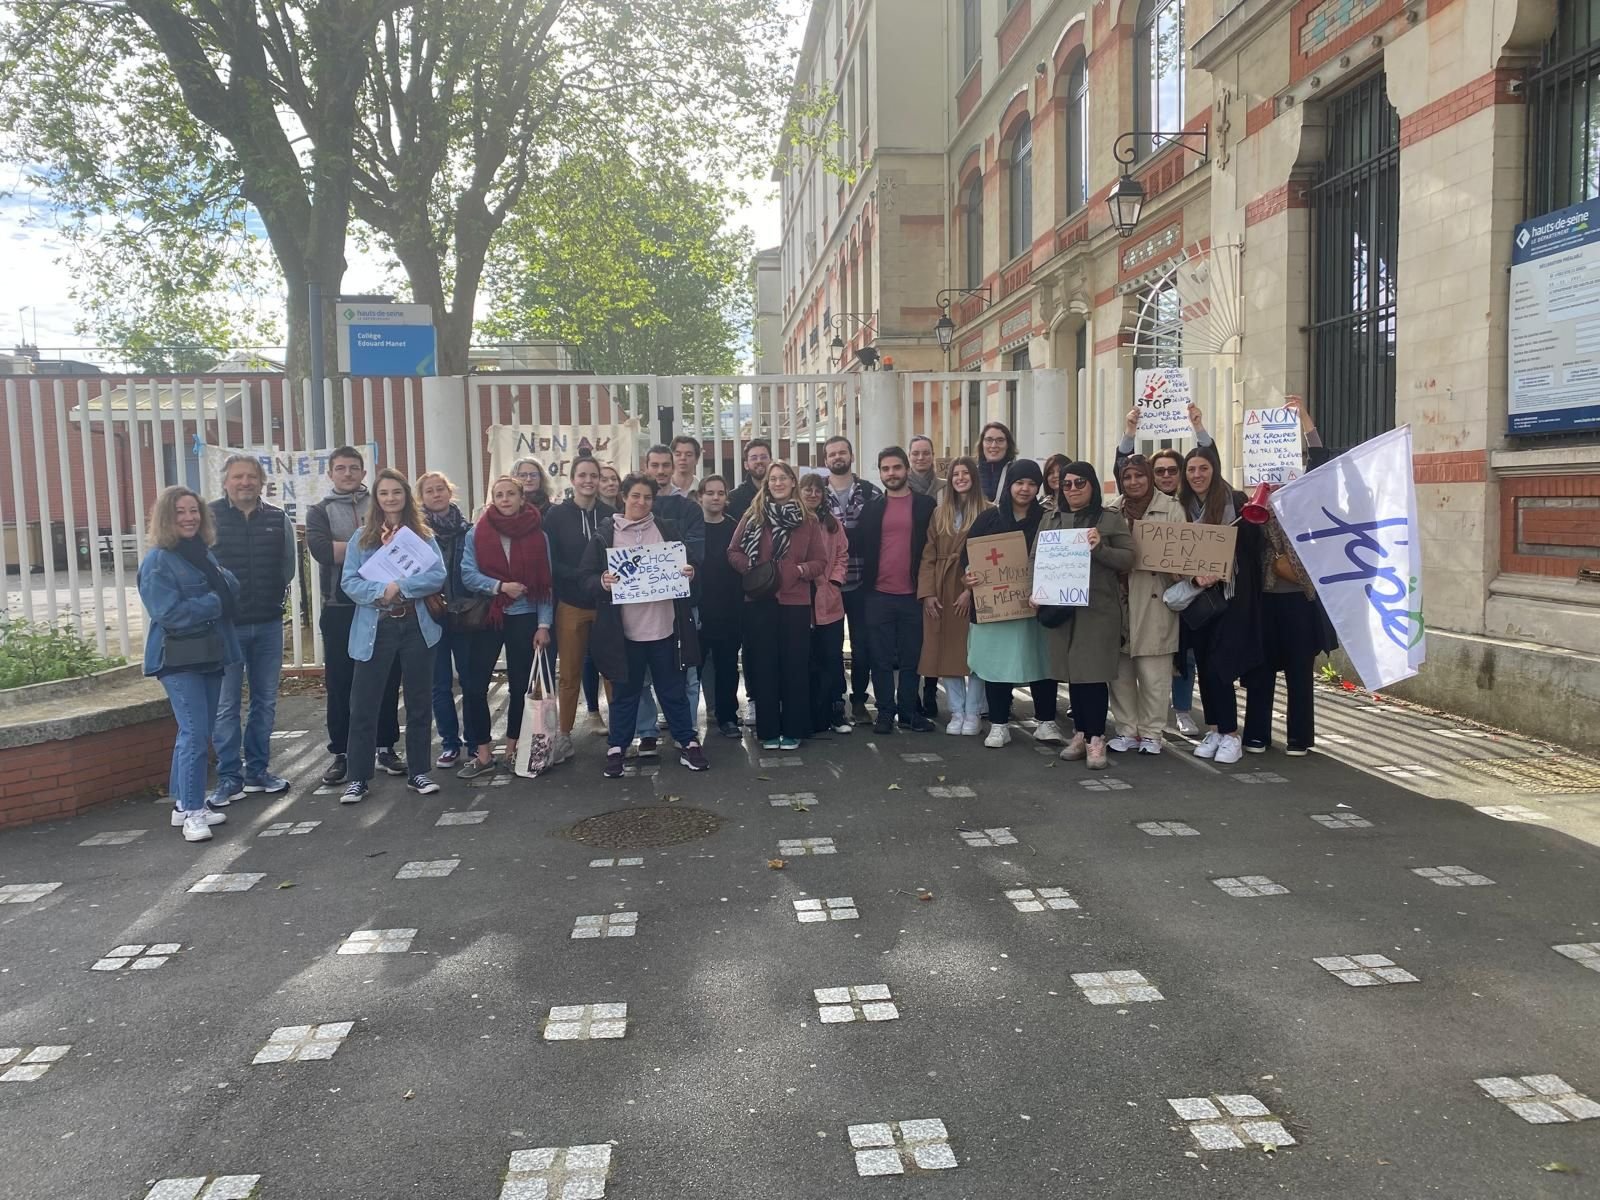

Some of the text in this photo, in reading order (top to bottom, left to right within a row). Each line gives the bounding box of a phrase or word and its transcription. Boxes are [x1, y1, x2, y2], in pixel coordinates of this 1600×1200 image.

[1531, 211, 1589, 238] hauts-de-seine
[385, 340, 407, 348] Manet
[1137, 398, 1172, 409] STOP
[1260, 408, 1299, 424] NON
[516, 432, 567, 453] NON
[1245, 431, 1297, 441] AUX GROUPES
[258, 456, 330, 475] ANET
[1250, 473, 1282, 485] NON
[1039, 530, 1061, 544] NON
[1139, 522, 1227, 543] PARENTS
[1163, 542, 1196, 558] EN
[639, 552, 676, 566] CHOC
[639, 565, 661, 575] DES
[1059, 587, 1089, 603] NON
